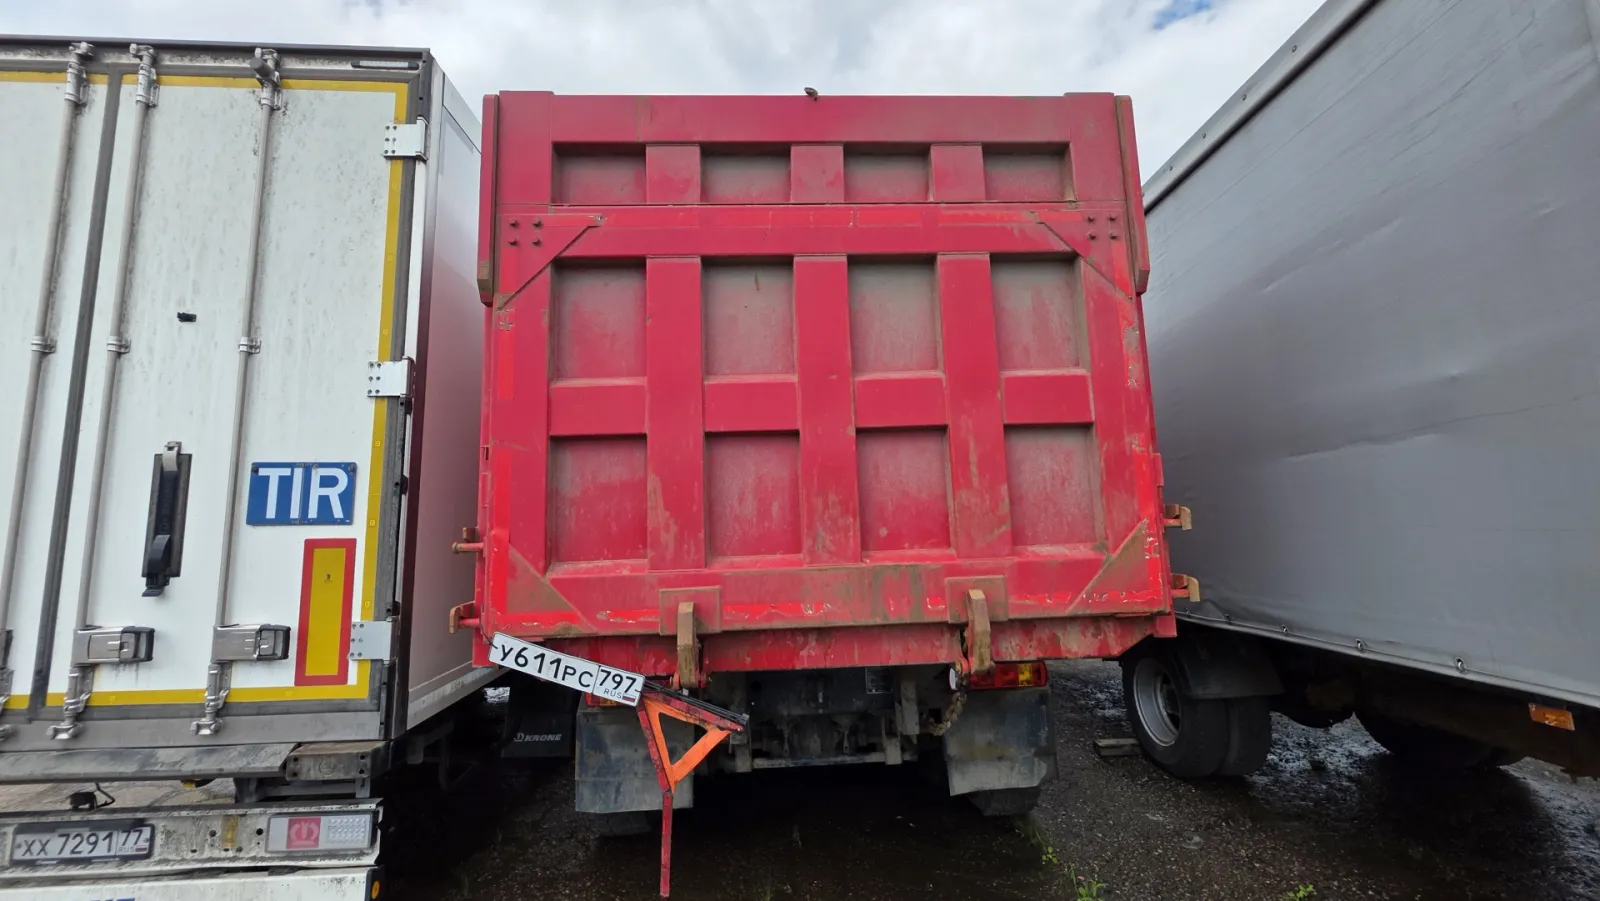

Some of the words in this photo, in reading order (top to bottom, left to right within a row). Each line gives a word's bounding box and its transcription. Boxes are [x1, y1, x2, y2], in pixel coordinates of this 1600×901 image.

[258, 468, 348, 519] TIR
[599, 669, 637, 693] 797
[603, 688, 622, 699] RUS
[524, 733, 562, 742] KRONE
[57, 832, 114, 855] 7291
[121, 829, 143, 846] 77
